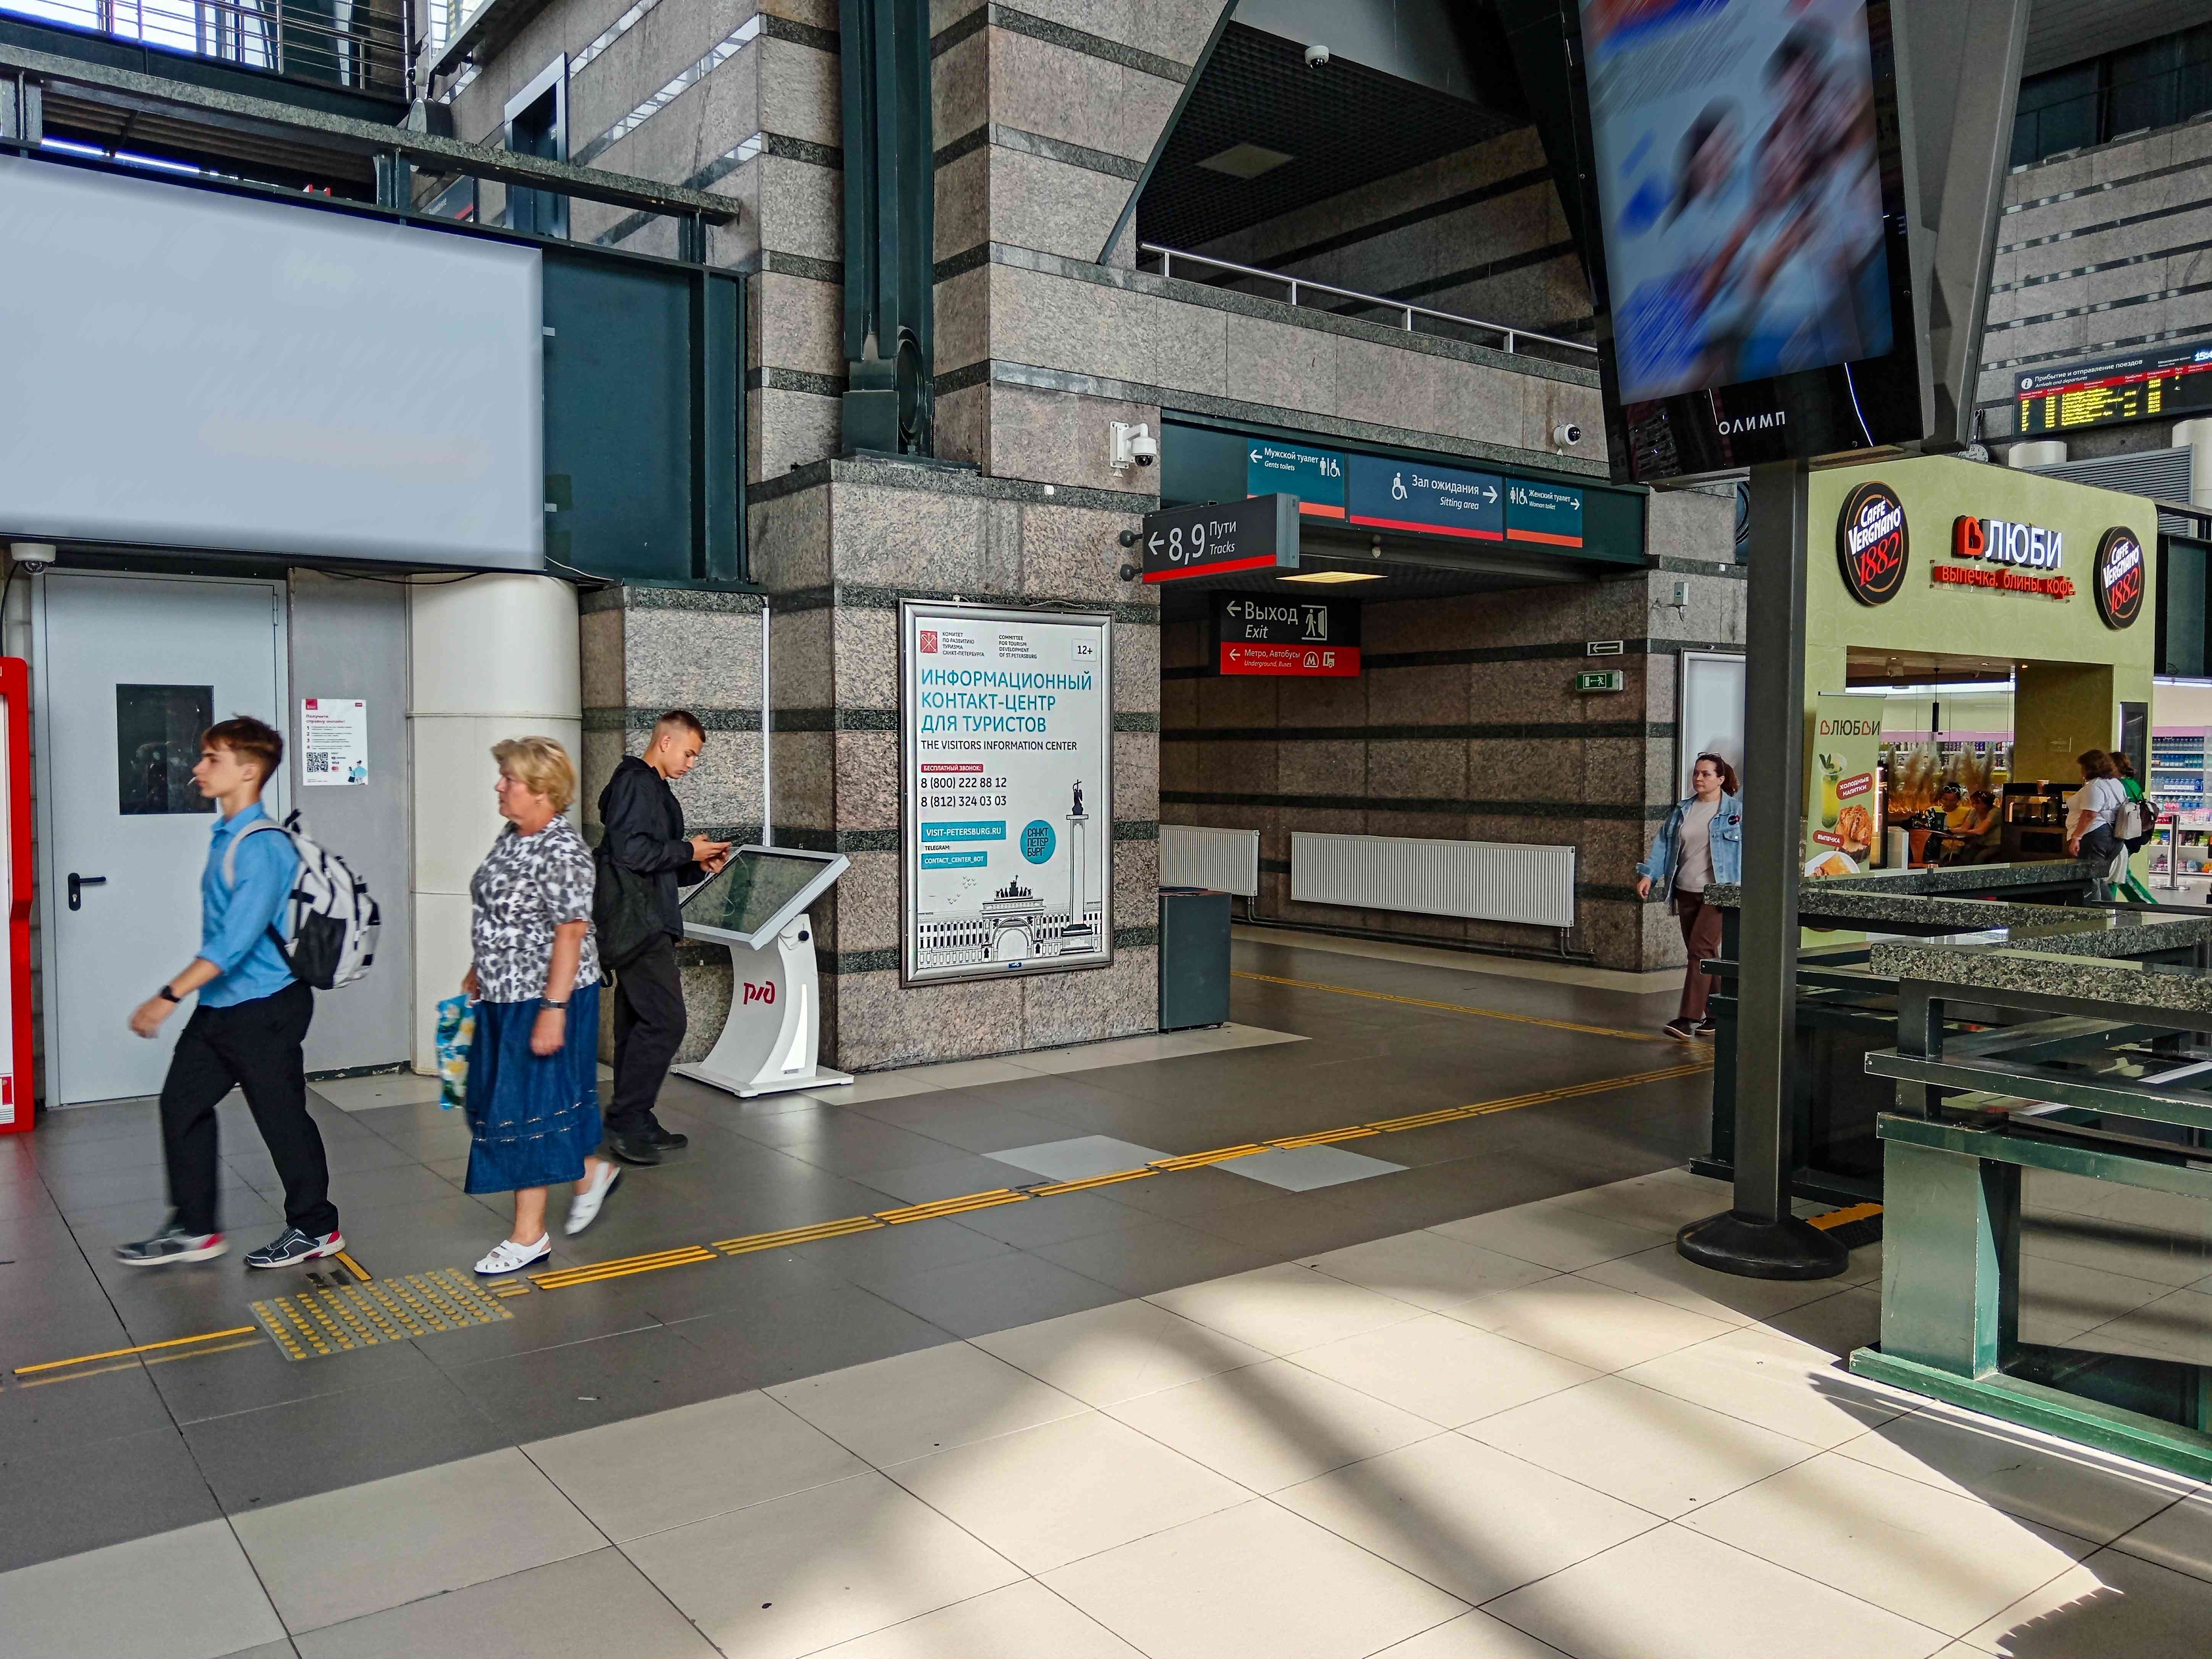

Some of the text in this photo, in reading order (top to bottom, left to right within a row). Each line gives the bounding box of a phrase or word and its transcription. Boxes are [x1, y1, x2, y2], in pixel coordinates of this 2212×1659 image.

[2035, 372, 2066, 382] Прибытие
[2073, 364, 2115, 375] отправление
[2116, 359, 2143, 369] поездов
[1718, 411, 1785, 435] ОЛИМП
[1264, 447, 1319, 464] Мужской туалет
[1264, 461, 1295, 471] Gents toilets
[1412, 474, 1479, 495] Зал ожидания
[1529, 489, 1570, 502] Женский туалет
[1440, 496, 1479, 510] Sitting area
[1209, 521, 1236, 539] Пути
[1169, 524, 1205, 565] 8,9
[1209, 541, 1235, 555] Tracks
[1859, 532, 1899, 587] 1882
[2111, 567, 2138, 614] 1882
[1245, 601, 1298, 625] Выход
[1245, 624, 1268, 638] Exit
[1077, 645, 1093, 655] 12+
[1244, 649, 1300, 659] Метро, Автобусы
[921, 669, 1092, 690] ИНФОРМАЦИОННЫЙ
[922, 692, 1056, 712] КОНТАКТ-ЦЕНТР
[921, 715, 1046, 733] ДЛЯ ТУРИСТОВ
[921, 740, 1077, 750] THE VISITORS INFORMATION CENTER
[921, 777, 1006, 789] 8 (800) 222 88 12
[1839, 776, 1869, 790] ХОЛОДНЫЕ
[1842, 784, 1867, 797] НАПИТКИ
[921, 796, 1006, 808] 8 (812) 324 03 03
[926, 827, 1001, 836] VISIT-PETERSBURG.RU
[1027, 827, 1049, 837] САНКТ
[1027, 838, 1049, 847] ПЕТЕР
[1817, 834, 1841, 844] ВЫПЕЧКА
[1027, 847, 1045, 857] БУРГ
[924, 856, 984, 864] CONTACT_CENTER_BOT
